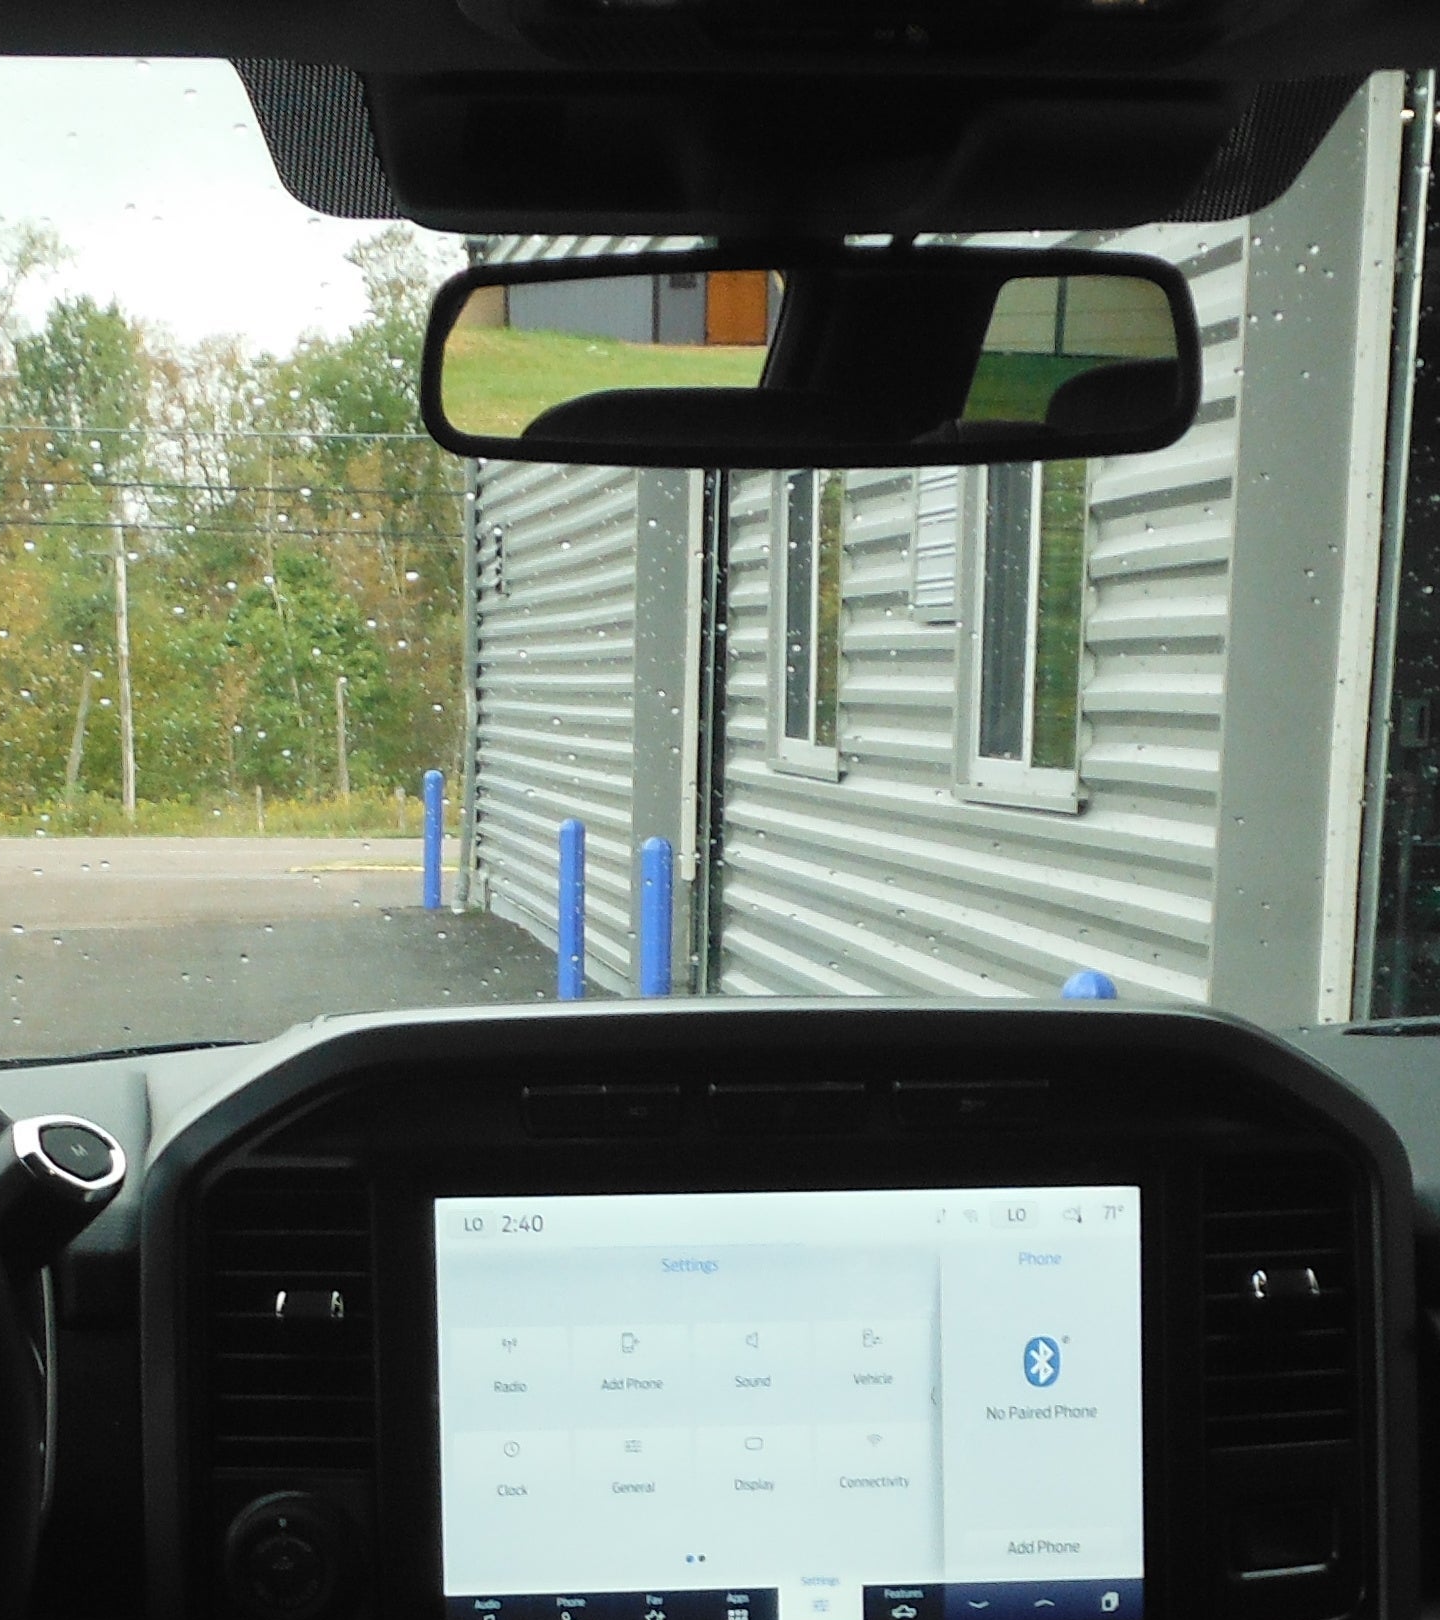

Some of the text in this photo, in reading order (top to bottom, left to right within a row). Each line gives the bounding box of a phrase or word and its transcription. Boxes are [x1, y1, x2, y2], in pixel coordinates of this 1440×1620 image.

[1007, 1208, 1027, 1222] LO
[463, 1217, 484, 1232] LO
[501, 1214, 544, 1233] 2:40
[661, 1256, 719, 1275] Settings
[1018, 1252, 1062, 1266] Phone
[493, 1380, 527, 1393] Radio
[601, 1378, 664, 1391] Add Phone
[735, 1375, 771, 1388] Sound
[853, 1373, 893, 1386] Vehicle
[986, 1404, 1098, 1420] No Paired Phone
[612, 1481, 656, 1494] General
[733, 1478, 774, 1493] Display
[839, 1475, 910, 1489] Connectivity
[497, 1484, 528, 1497] Clock
[1007, 1539, 1080, 1555] Add Phone
[884, 1588, 924, 1600] Features
